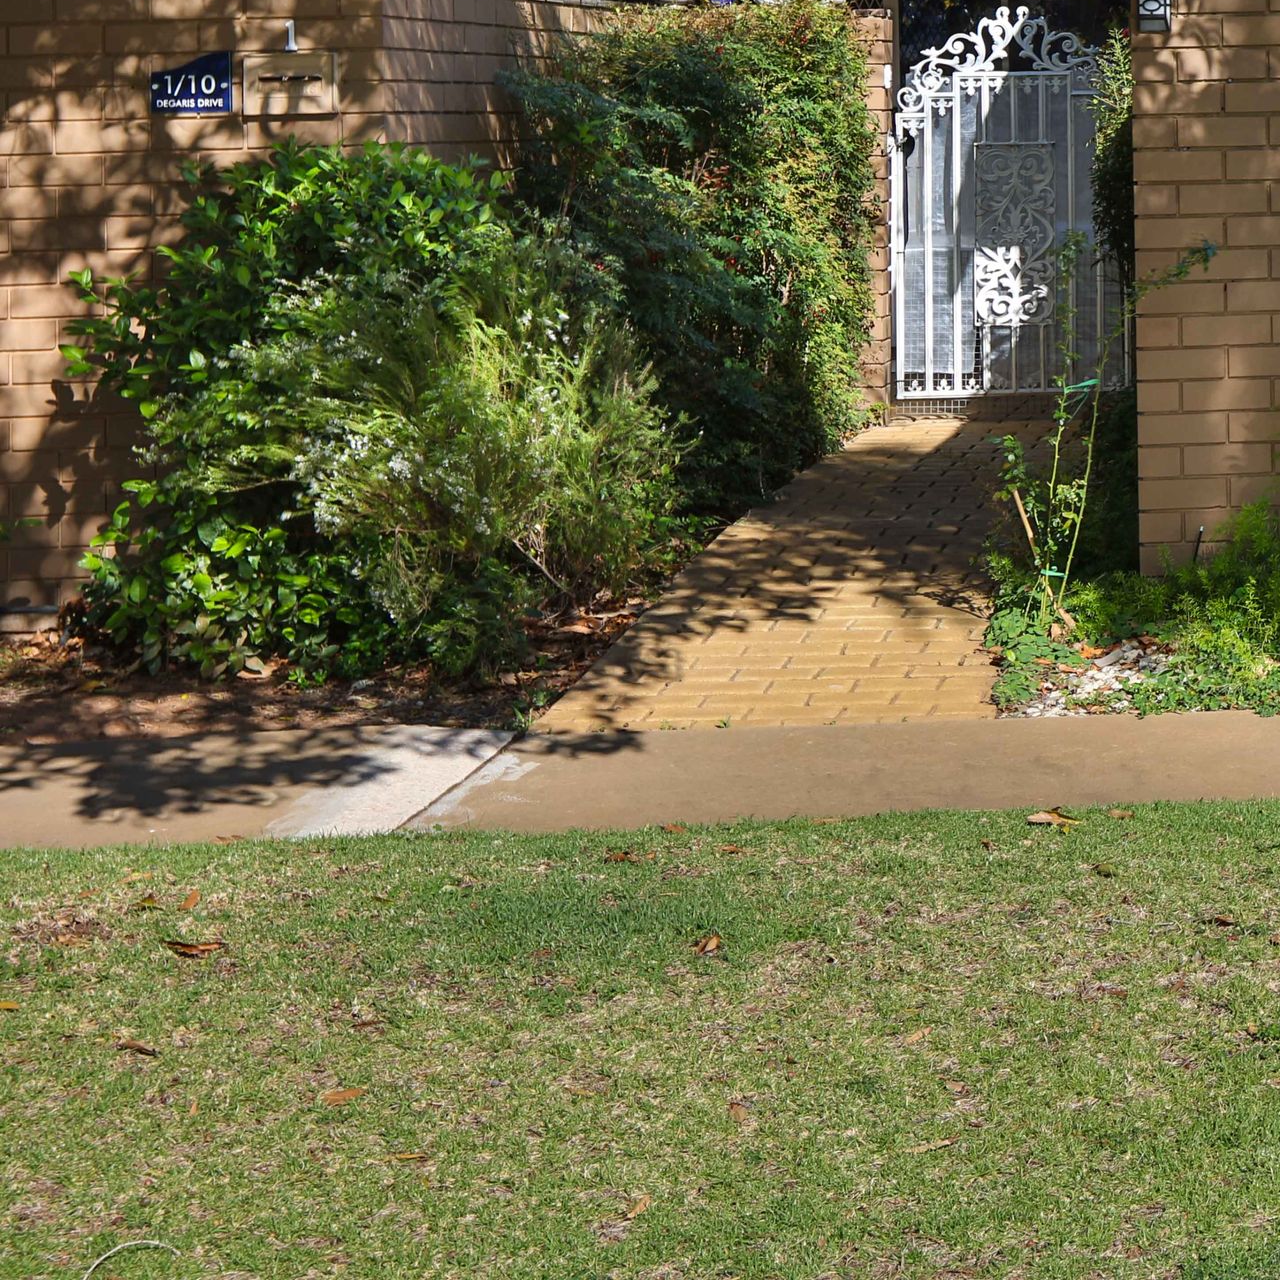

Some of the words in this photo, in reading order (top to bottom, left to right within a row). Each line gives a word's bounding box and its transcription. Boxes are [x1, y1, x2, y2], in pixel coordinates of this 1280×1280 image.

[285, 20, 298, 52] 1
[163, 74, 216, 96] 1/10
[156, 98, 196, 109] DEGARIS
[197, 98, 224, 108] DRIVE
